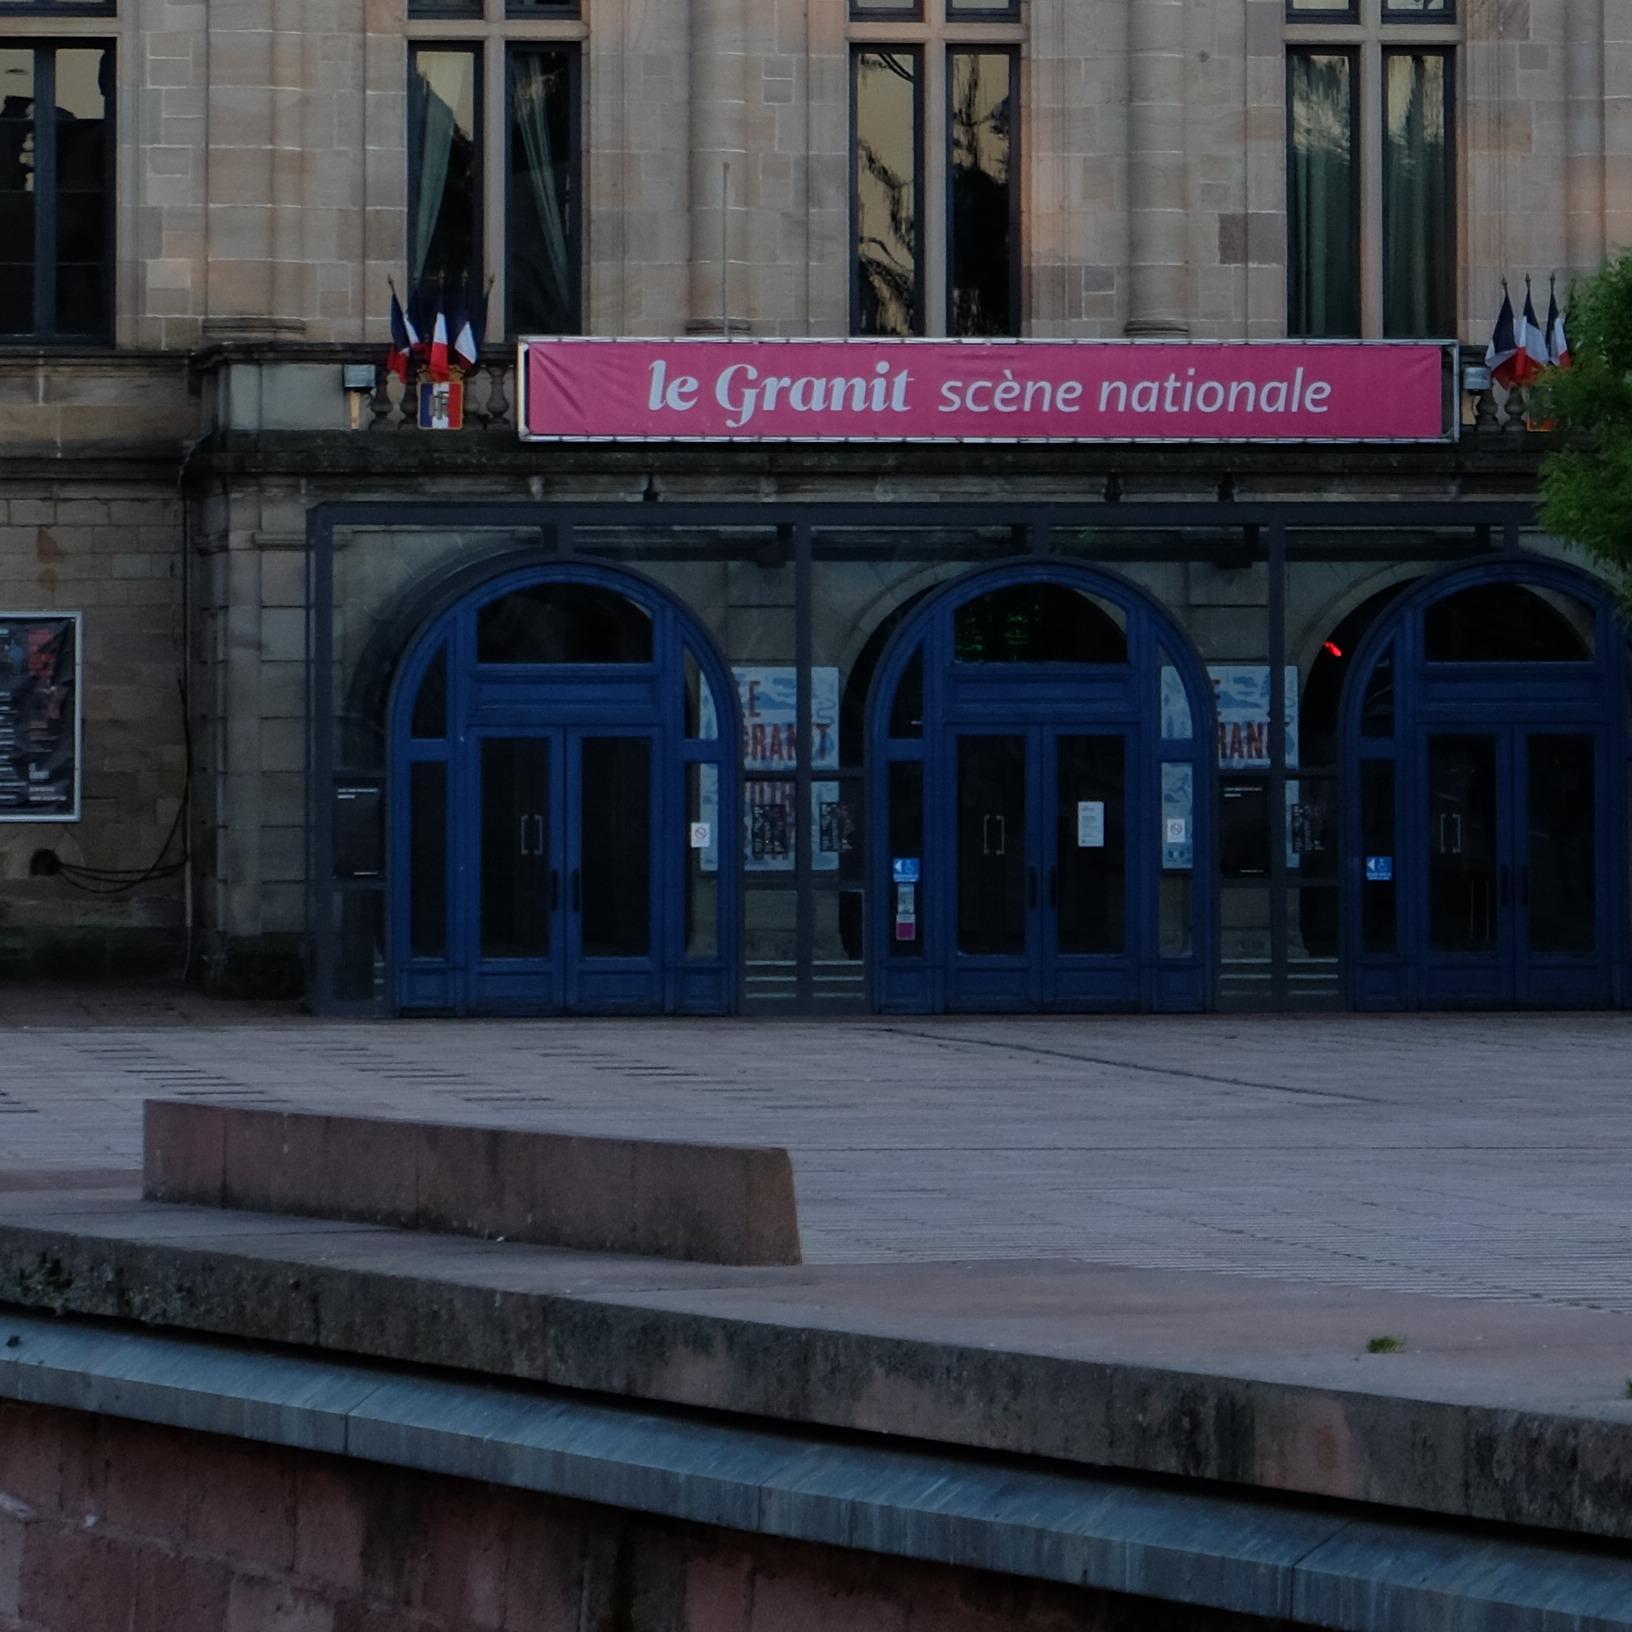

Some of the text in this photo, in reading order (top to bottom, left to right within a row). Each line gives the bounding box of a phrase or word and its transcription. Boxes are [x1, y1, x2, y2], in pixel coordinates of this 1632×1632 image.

[646, 358, 1332, 430] le Granit scène nationale
